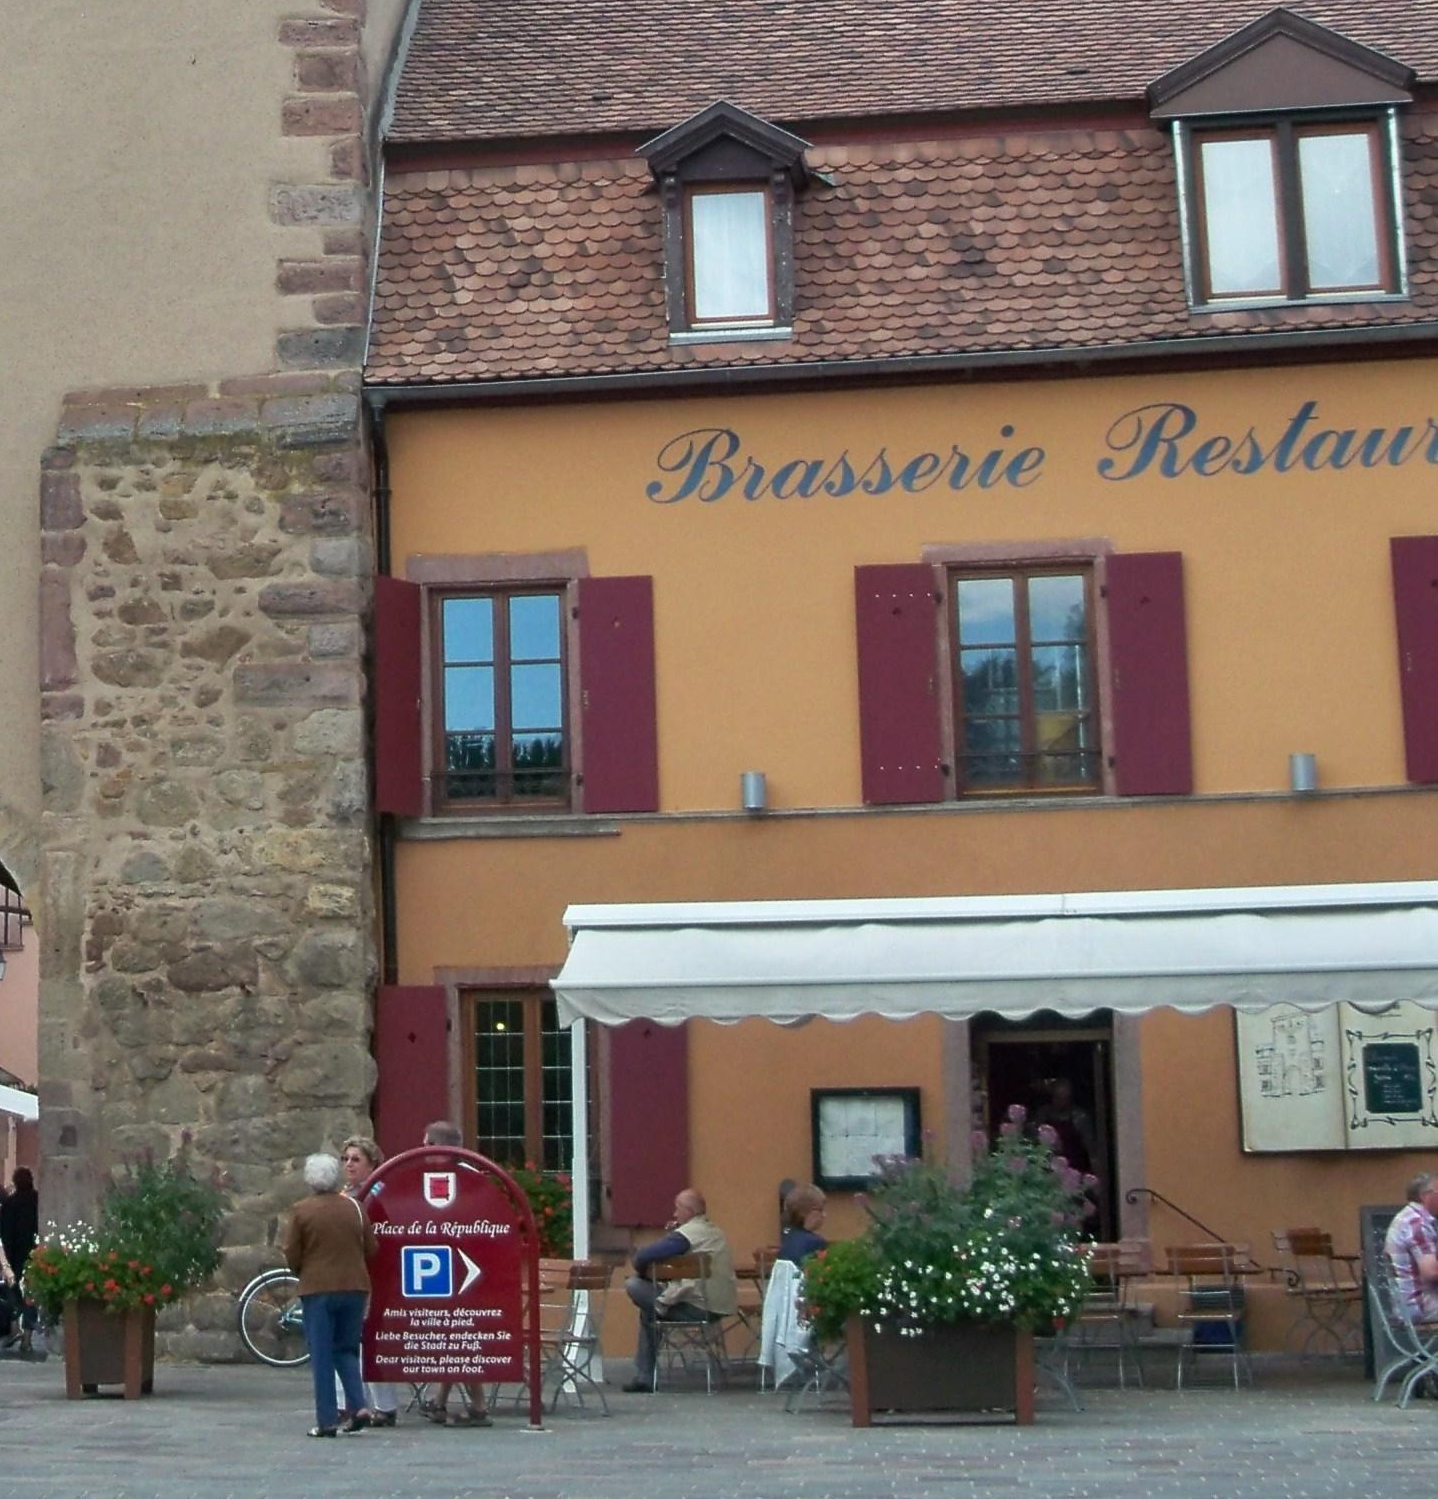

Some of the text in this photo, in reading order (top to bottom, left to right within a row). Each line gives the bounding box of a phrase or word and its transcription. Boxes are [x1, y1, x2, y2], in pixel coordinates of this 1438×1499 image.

[645, 423, 1046, 504] Brasserie
[373, 1219, 511, 1238] Place de la République
[413, 1252, 441, 1291] P
[383, 1307, 502, 1318] Amis visiteurs, découvrez
[410, 1318, 475, 1329] la ville à pied.
[375, 1332, 401, 1341] Liebe
[403, 1332, 447, 1341] Besucher,
[497, 1331, 512, 1341] Sie
[404, 1341, 419, 1350] die
[421, 1341, 447, 1350] Stadt
[461, 1341, 482, 1351] Fuß.
[375, 1355, 512, 1366] Dear visitors, please discover
[403, 1364, 484, 1374] our town on foot.
